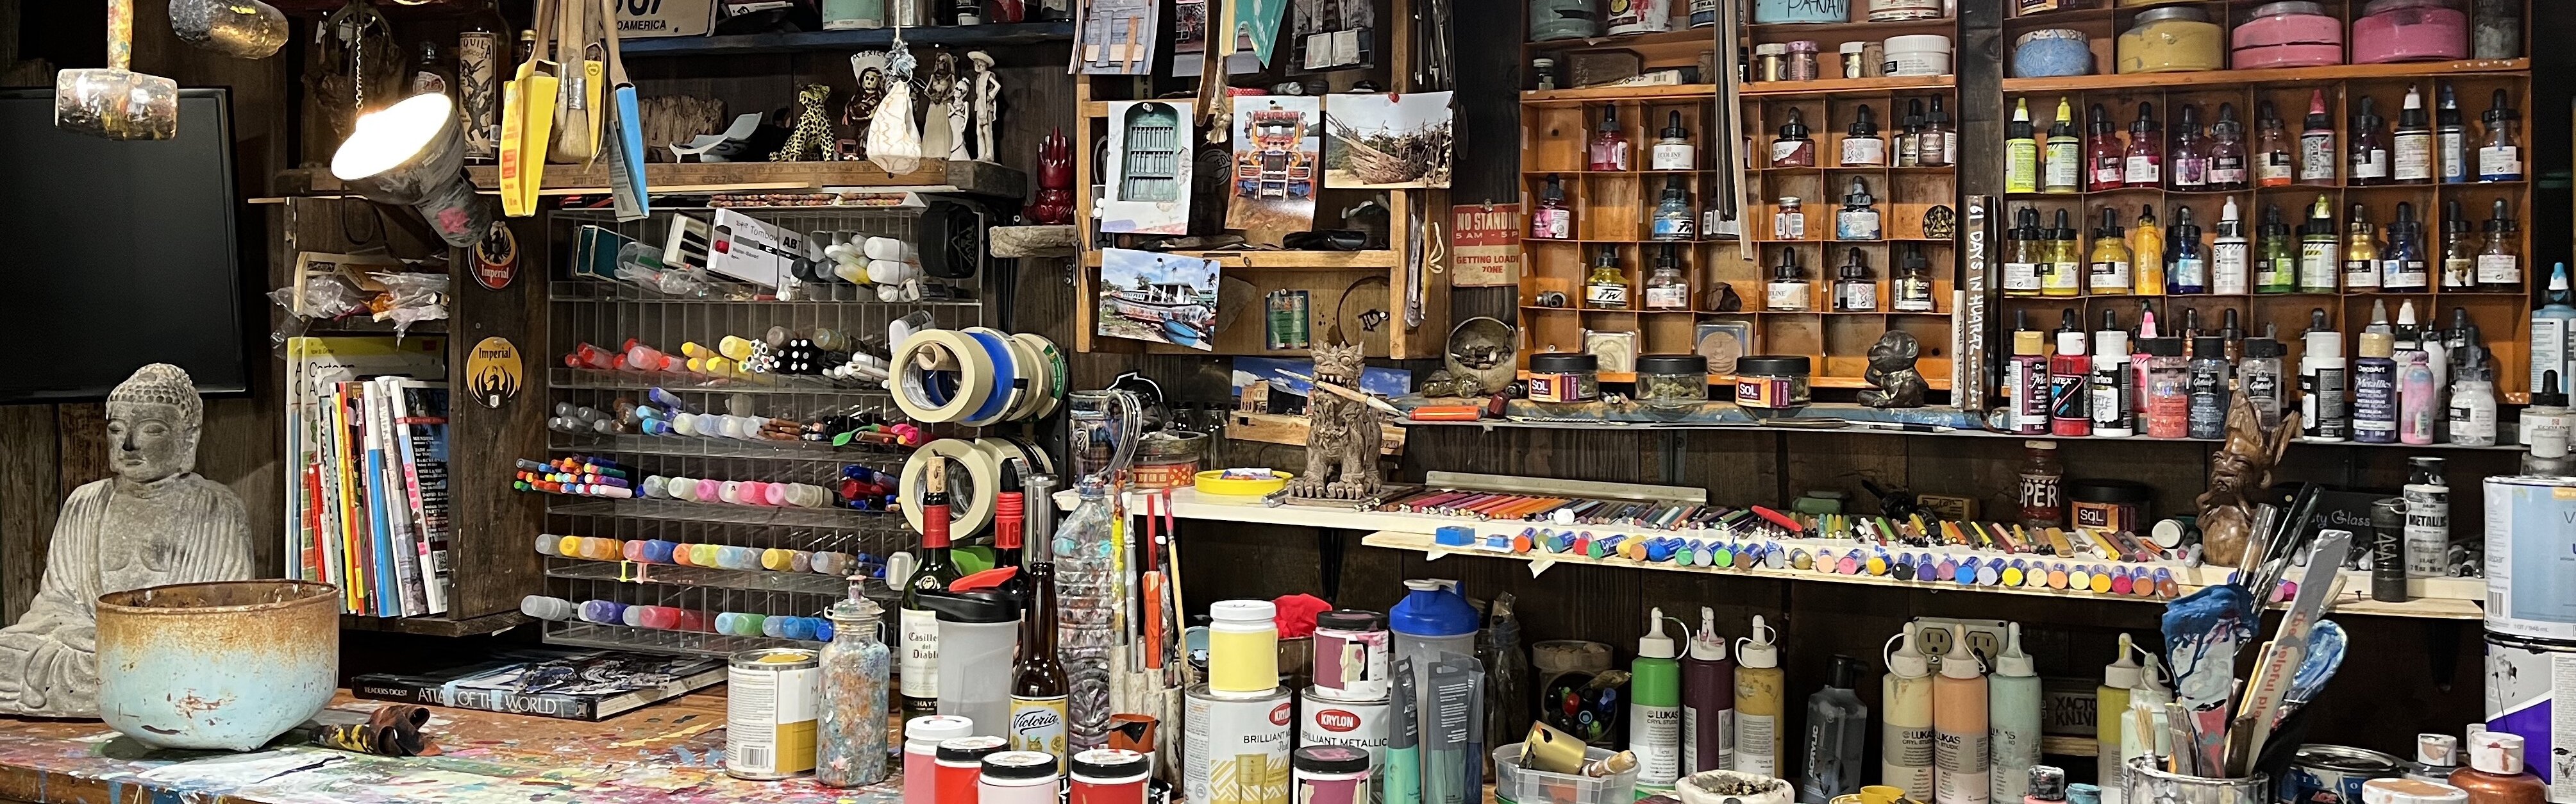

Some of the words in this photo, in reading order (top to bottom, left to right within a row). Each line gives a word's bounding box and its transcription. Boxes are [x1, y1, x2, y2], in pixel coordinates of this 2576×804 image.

[464, 38, 492, 60] QUILA
[1457, 213, 1471, 231] NO
[1474, 212, 1519, 231] STANDIN
[751, 226, 779, 242] Tombow
[1969, 231, 1984, 271] DAYS
[1456, 255, 1492, 264] GETTING
[1494, 255, 1519, 264] LOADI
[481, 264, 509, 283] Imperial
[1969, 276, 1984, 292] IN
[478, 347, 511, 361] Imperial
[2020, 483, 2061, 508] SPER
[2332, 510, 2371, 527] Glass
[2291, 611, 2307, 636] the
[908, 632, 937, 642] Casille
[913, 649, 939, 659] Diabl
[418, 687, 444, 704] ATLA
[457, 691, 479, 707] OF
[505, 695, 557, 714] WORLD
[1013, 710, 1058, 735] Victoria
[1275, 707, 1291, 722] KRYLO
[1321, 714, 1354, 728] KRYLON
[2055, 712, 2097, 726] KNIV
[1243, 732, 1285, 744] BRILLIANT
[1340, 737, 1387, 748] METALLIC
[1936, 732, 1961, 744] LUKAS
[1808, 725, 1819, 778] ACRYLIC
